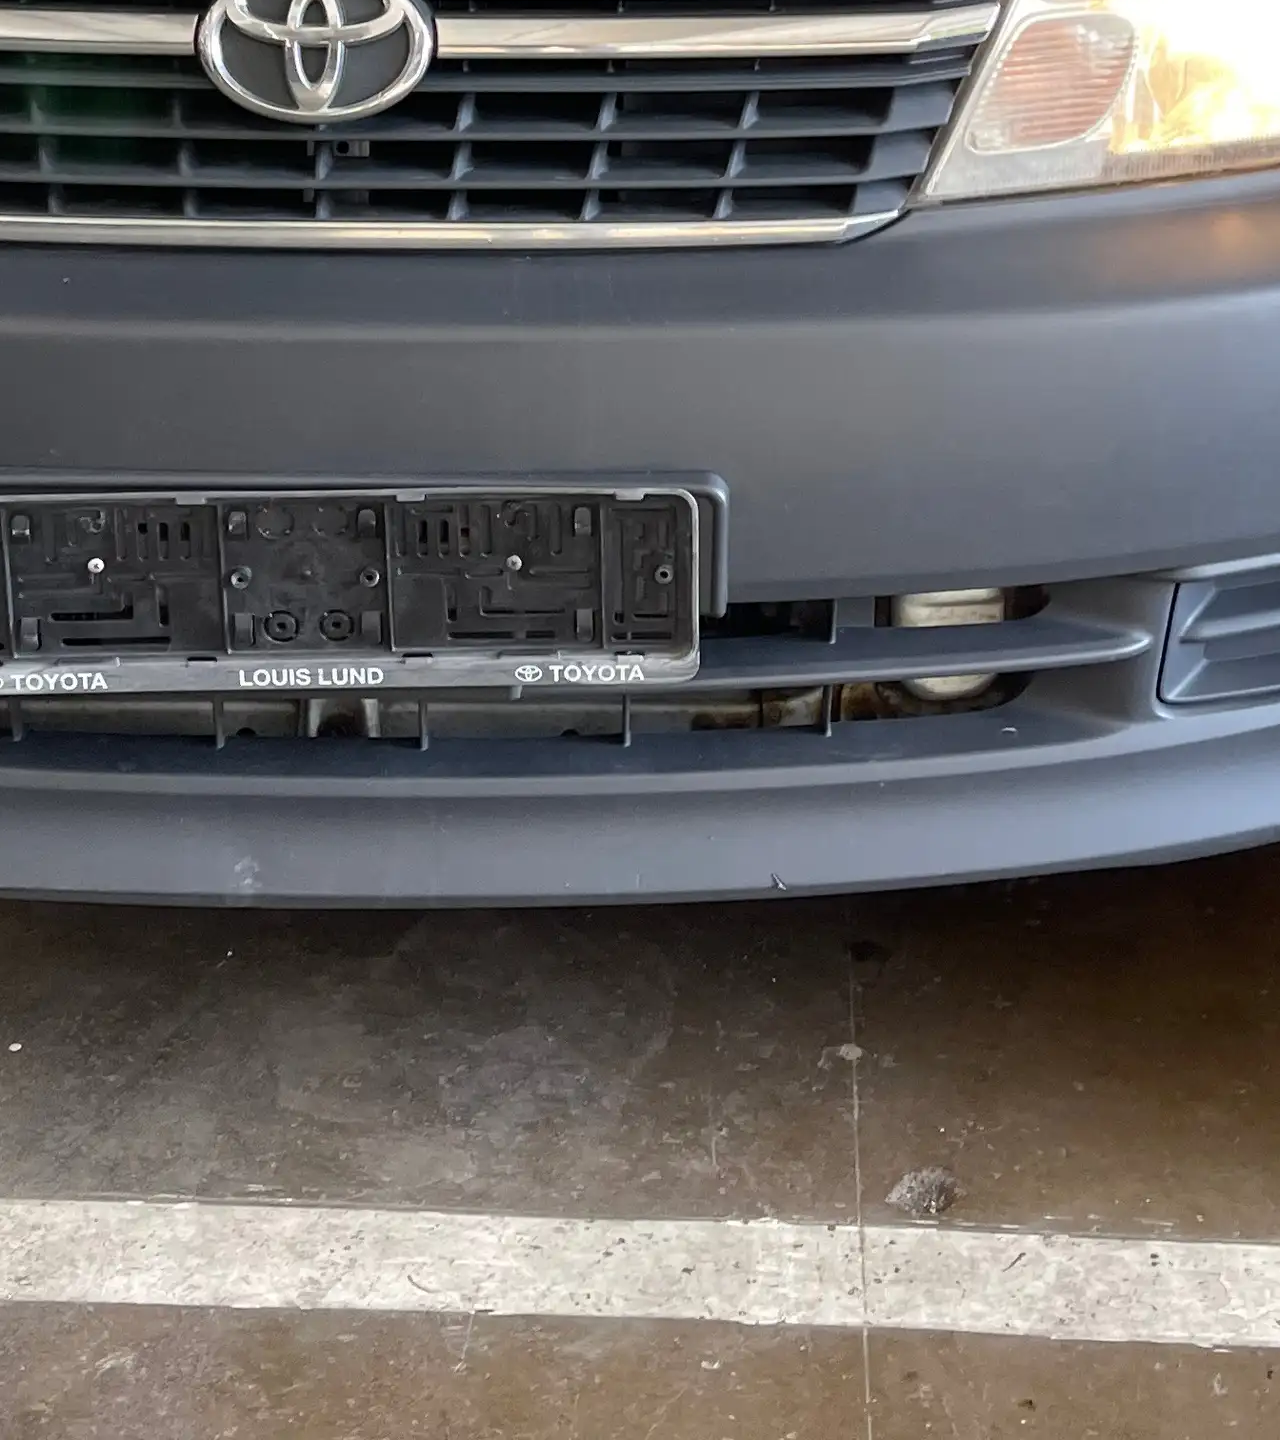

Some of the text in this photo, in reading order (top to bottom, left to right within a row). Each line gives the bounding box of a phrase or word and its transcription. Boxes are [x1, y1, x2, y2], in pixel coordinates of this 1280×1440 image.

[10, 672, 108, 691] TOYOTA
[239, 667, 384, 687] LOUIS LUND
[548, 664, 645, 682] TOYOTA
